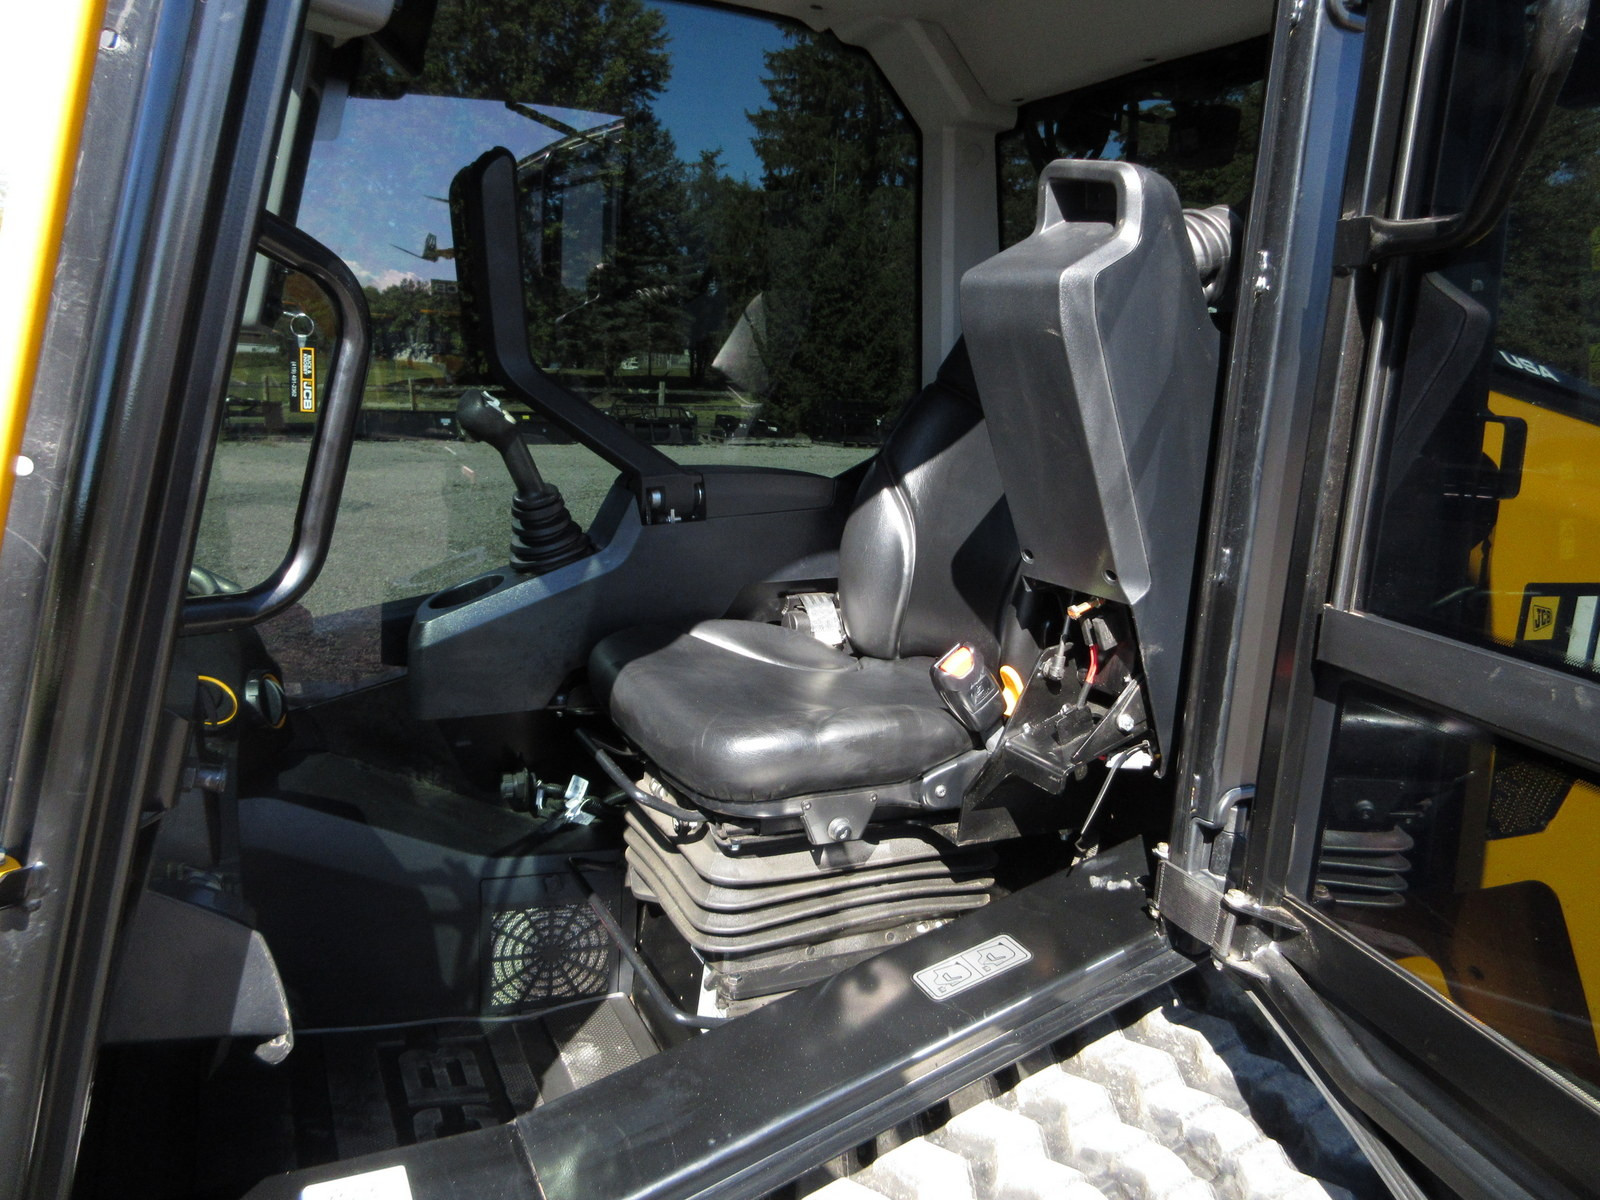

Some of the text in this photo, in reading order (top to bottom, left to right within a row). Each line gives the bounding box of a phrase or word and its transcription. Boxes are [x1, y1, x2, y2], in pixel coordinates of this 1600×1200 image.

[1499, 350, 1560, 382] USA
[303, 381, 312, 409] JCB
[1534, 607, 1552, 629] JCB
